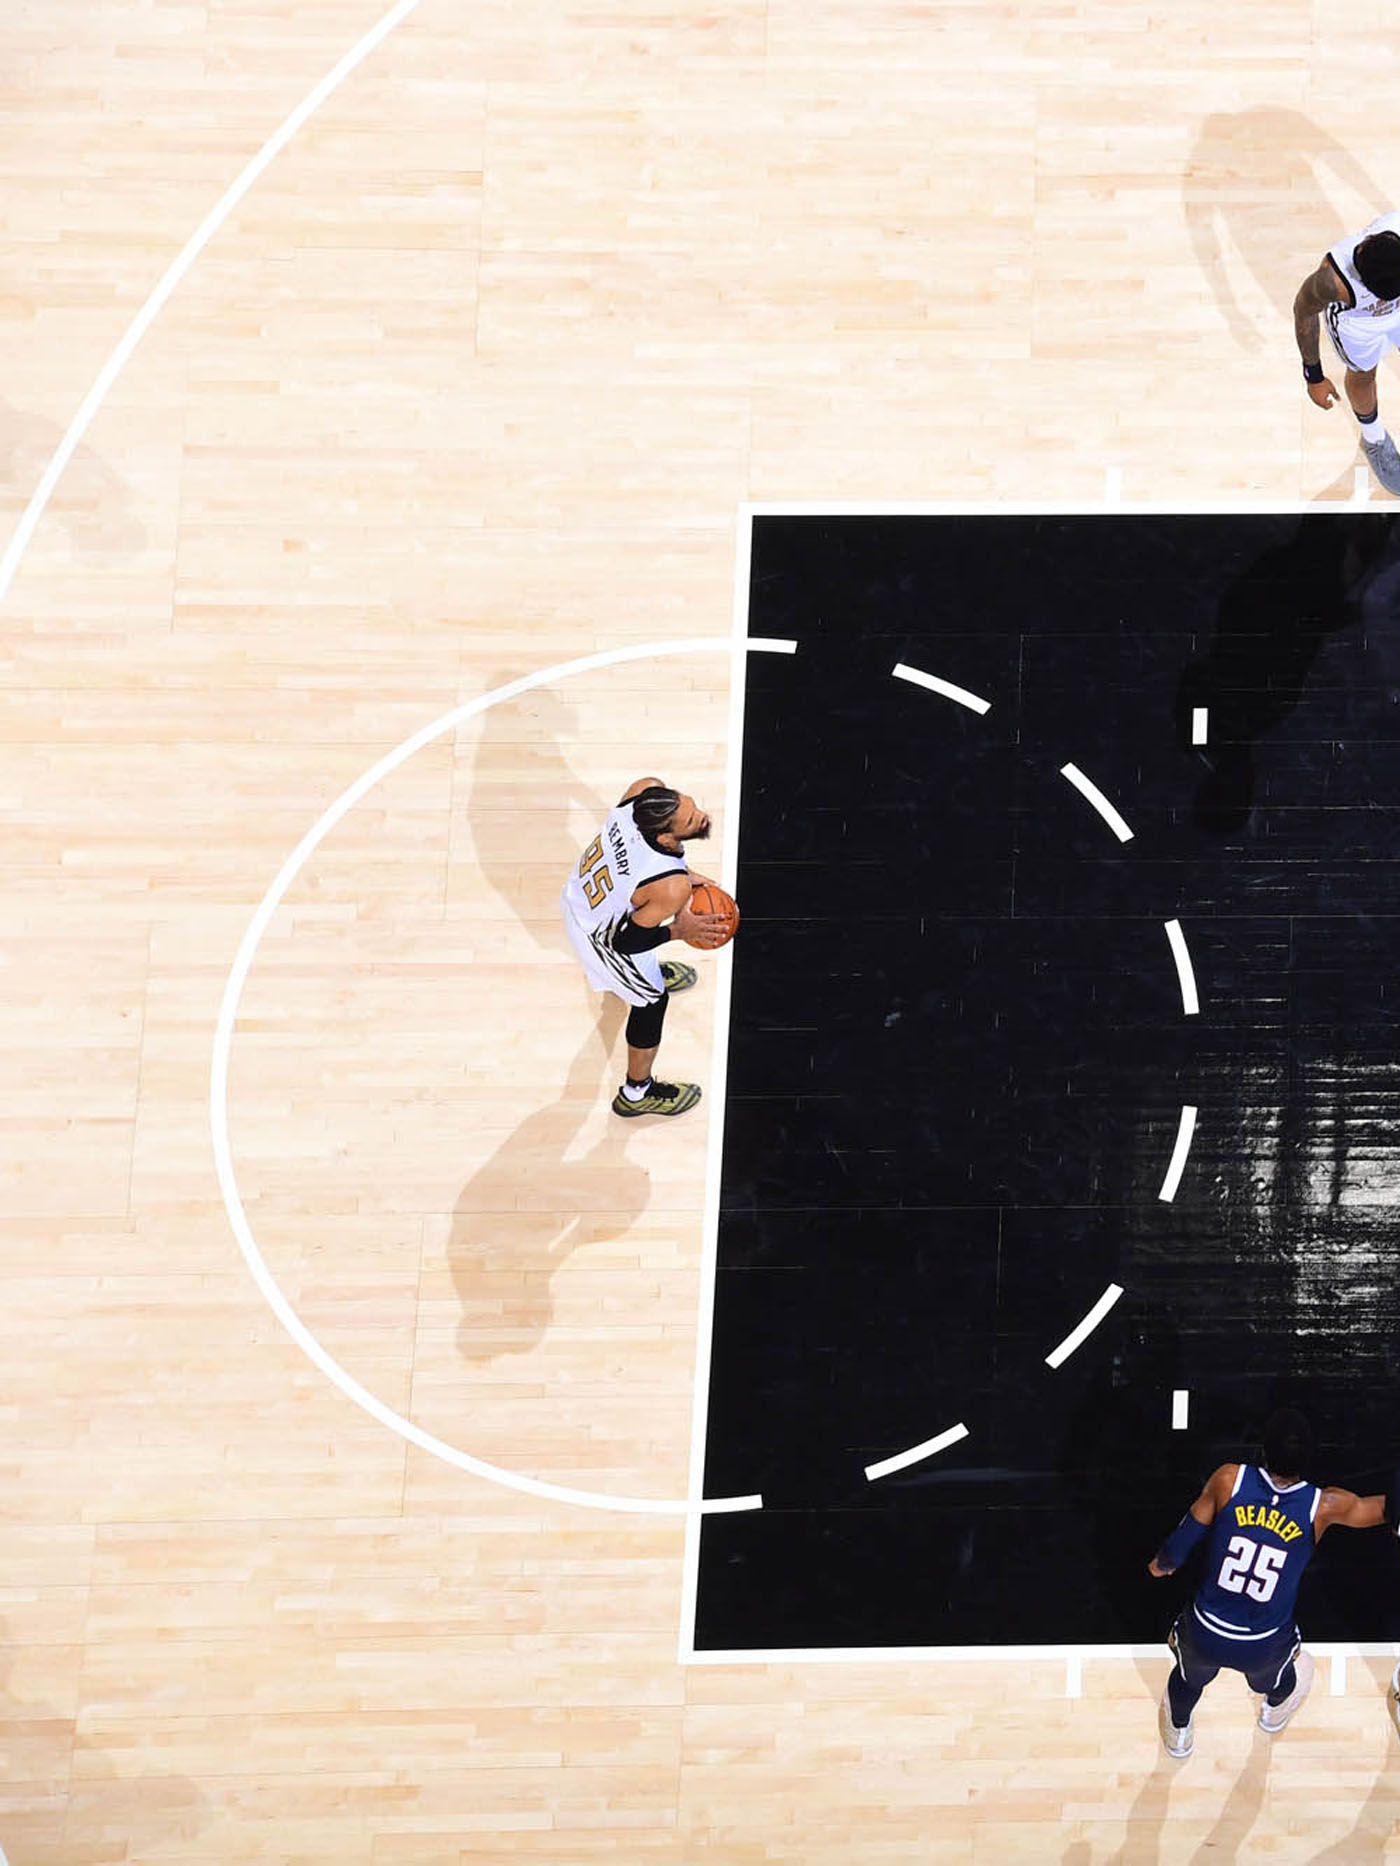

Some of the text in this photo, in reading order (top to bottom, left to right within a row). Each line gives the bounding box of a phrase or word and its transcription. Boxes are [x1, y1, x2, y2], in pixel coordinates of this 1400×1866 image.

[608, 821, 631, 877] BEMBRY
[1234, 1505, 1303, 1543] BEASLEY
[1217, 1535, 1288, 1602] 25
